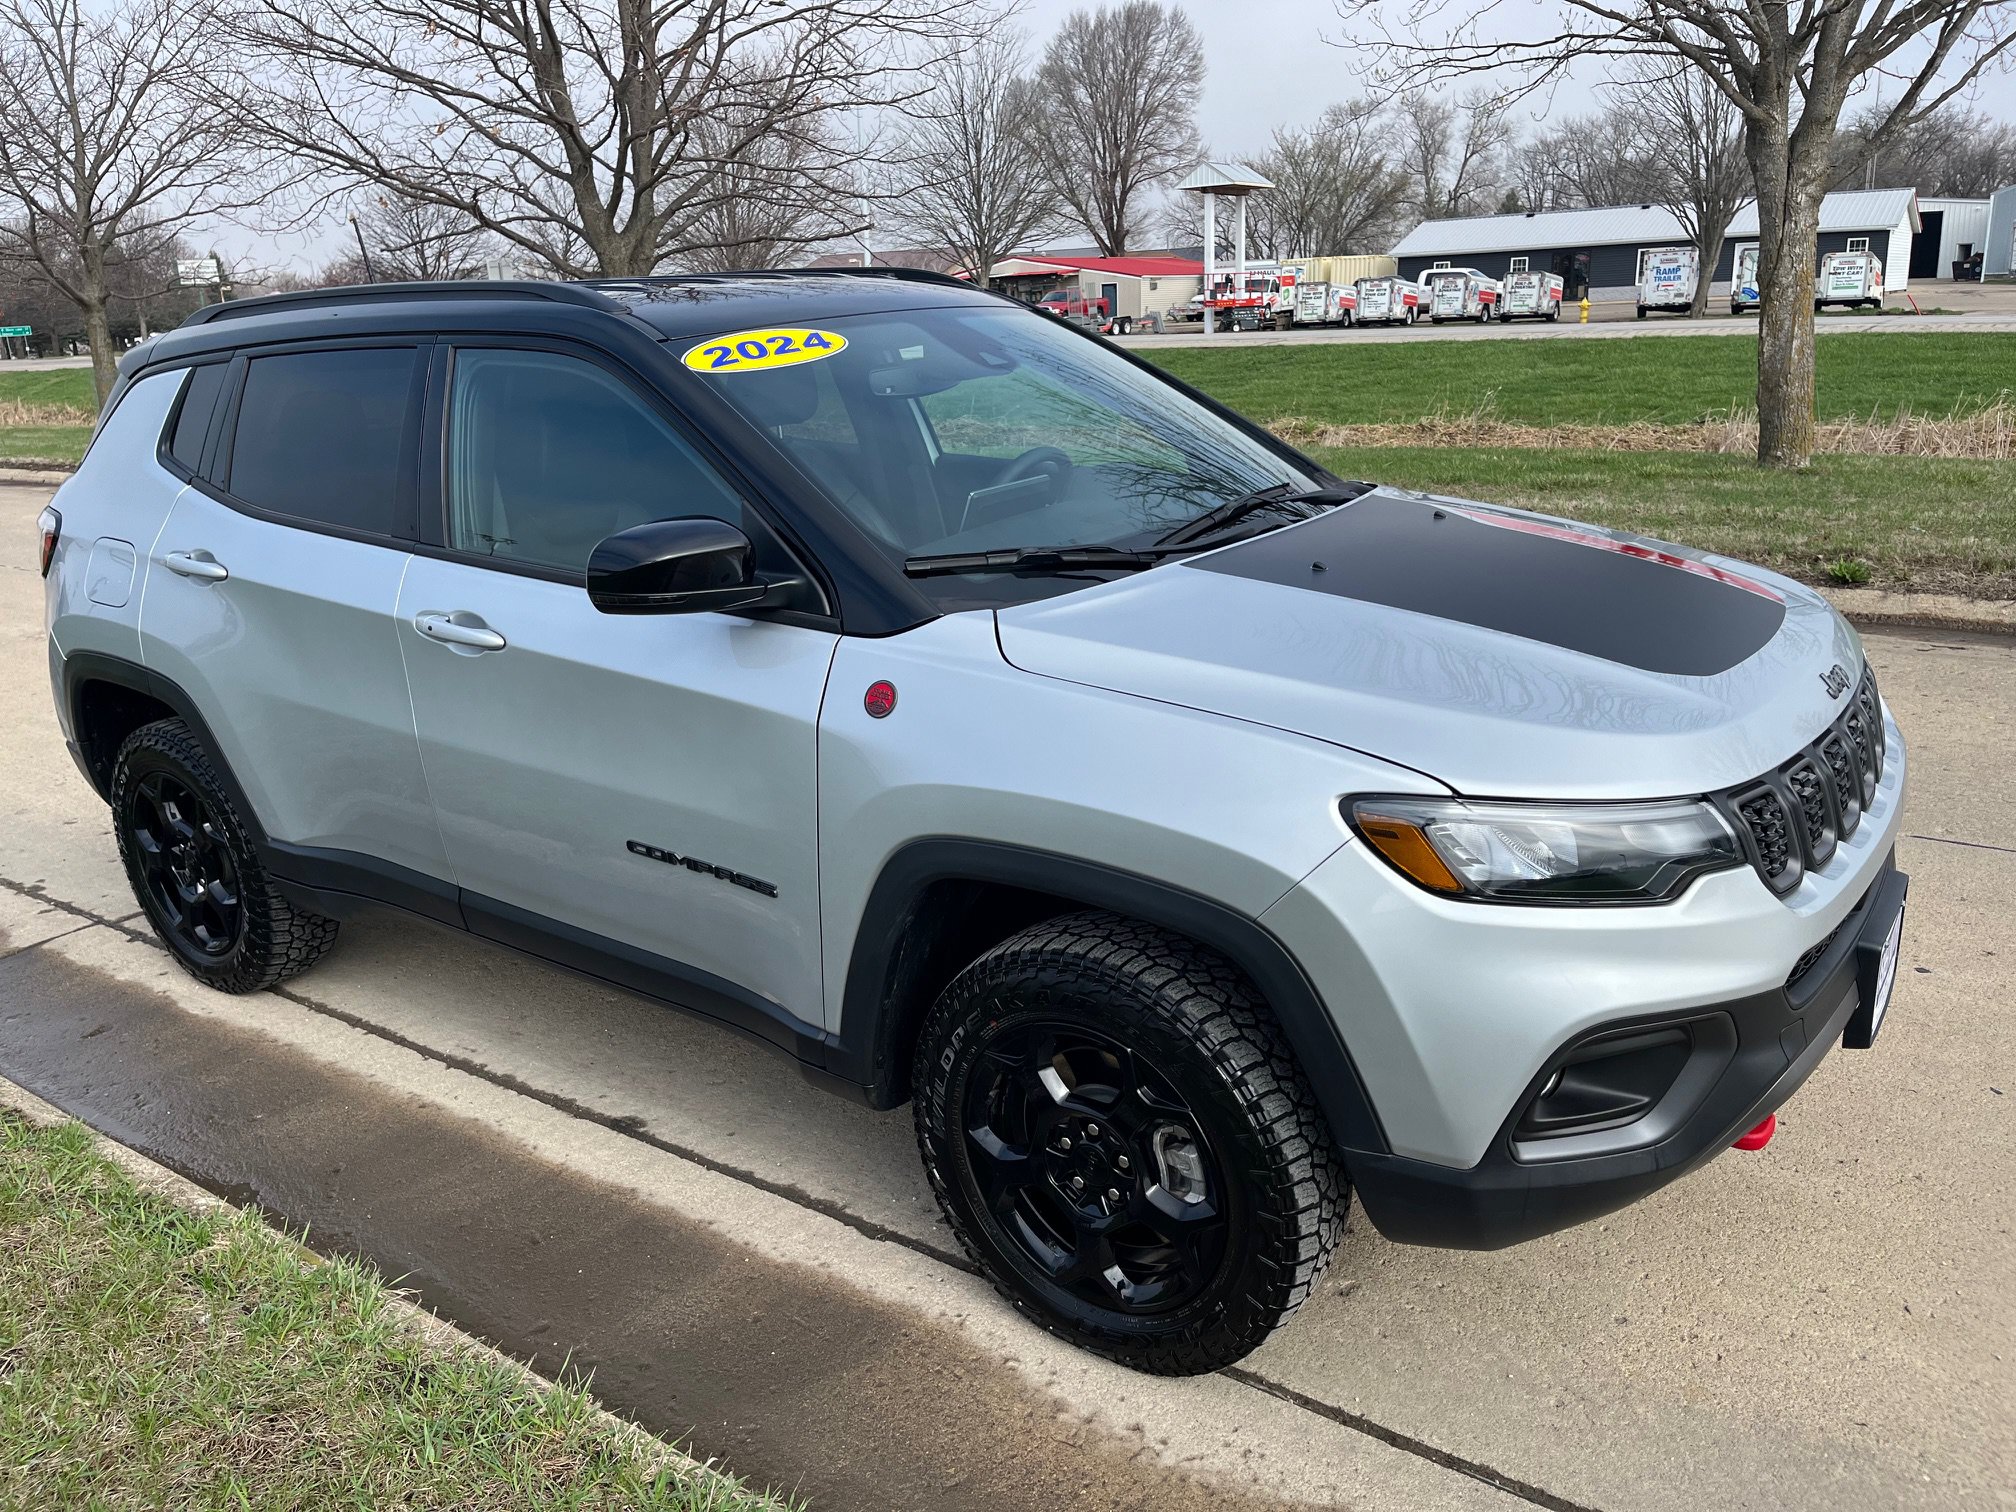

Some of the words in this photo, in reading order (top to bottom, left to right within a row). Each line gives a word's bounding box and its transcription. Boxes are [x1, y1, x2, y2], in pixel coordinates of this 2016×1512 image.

[1656, 267, 1681, 276] RAMP
[703, 332, 832, 369] 2024
[626, 839, 778, 898] COMPASS
